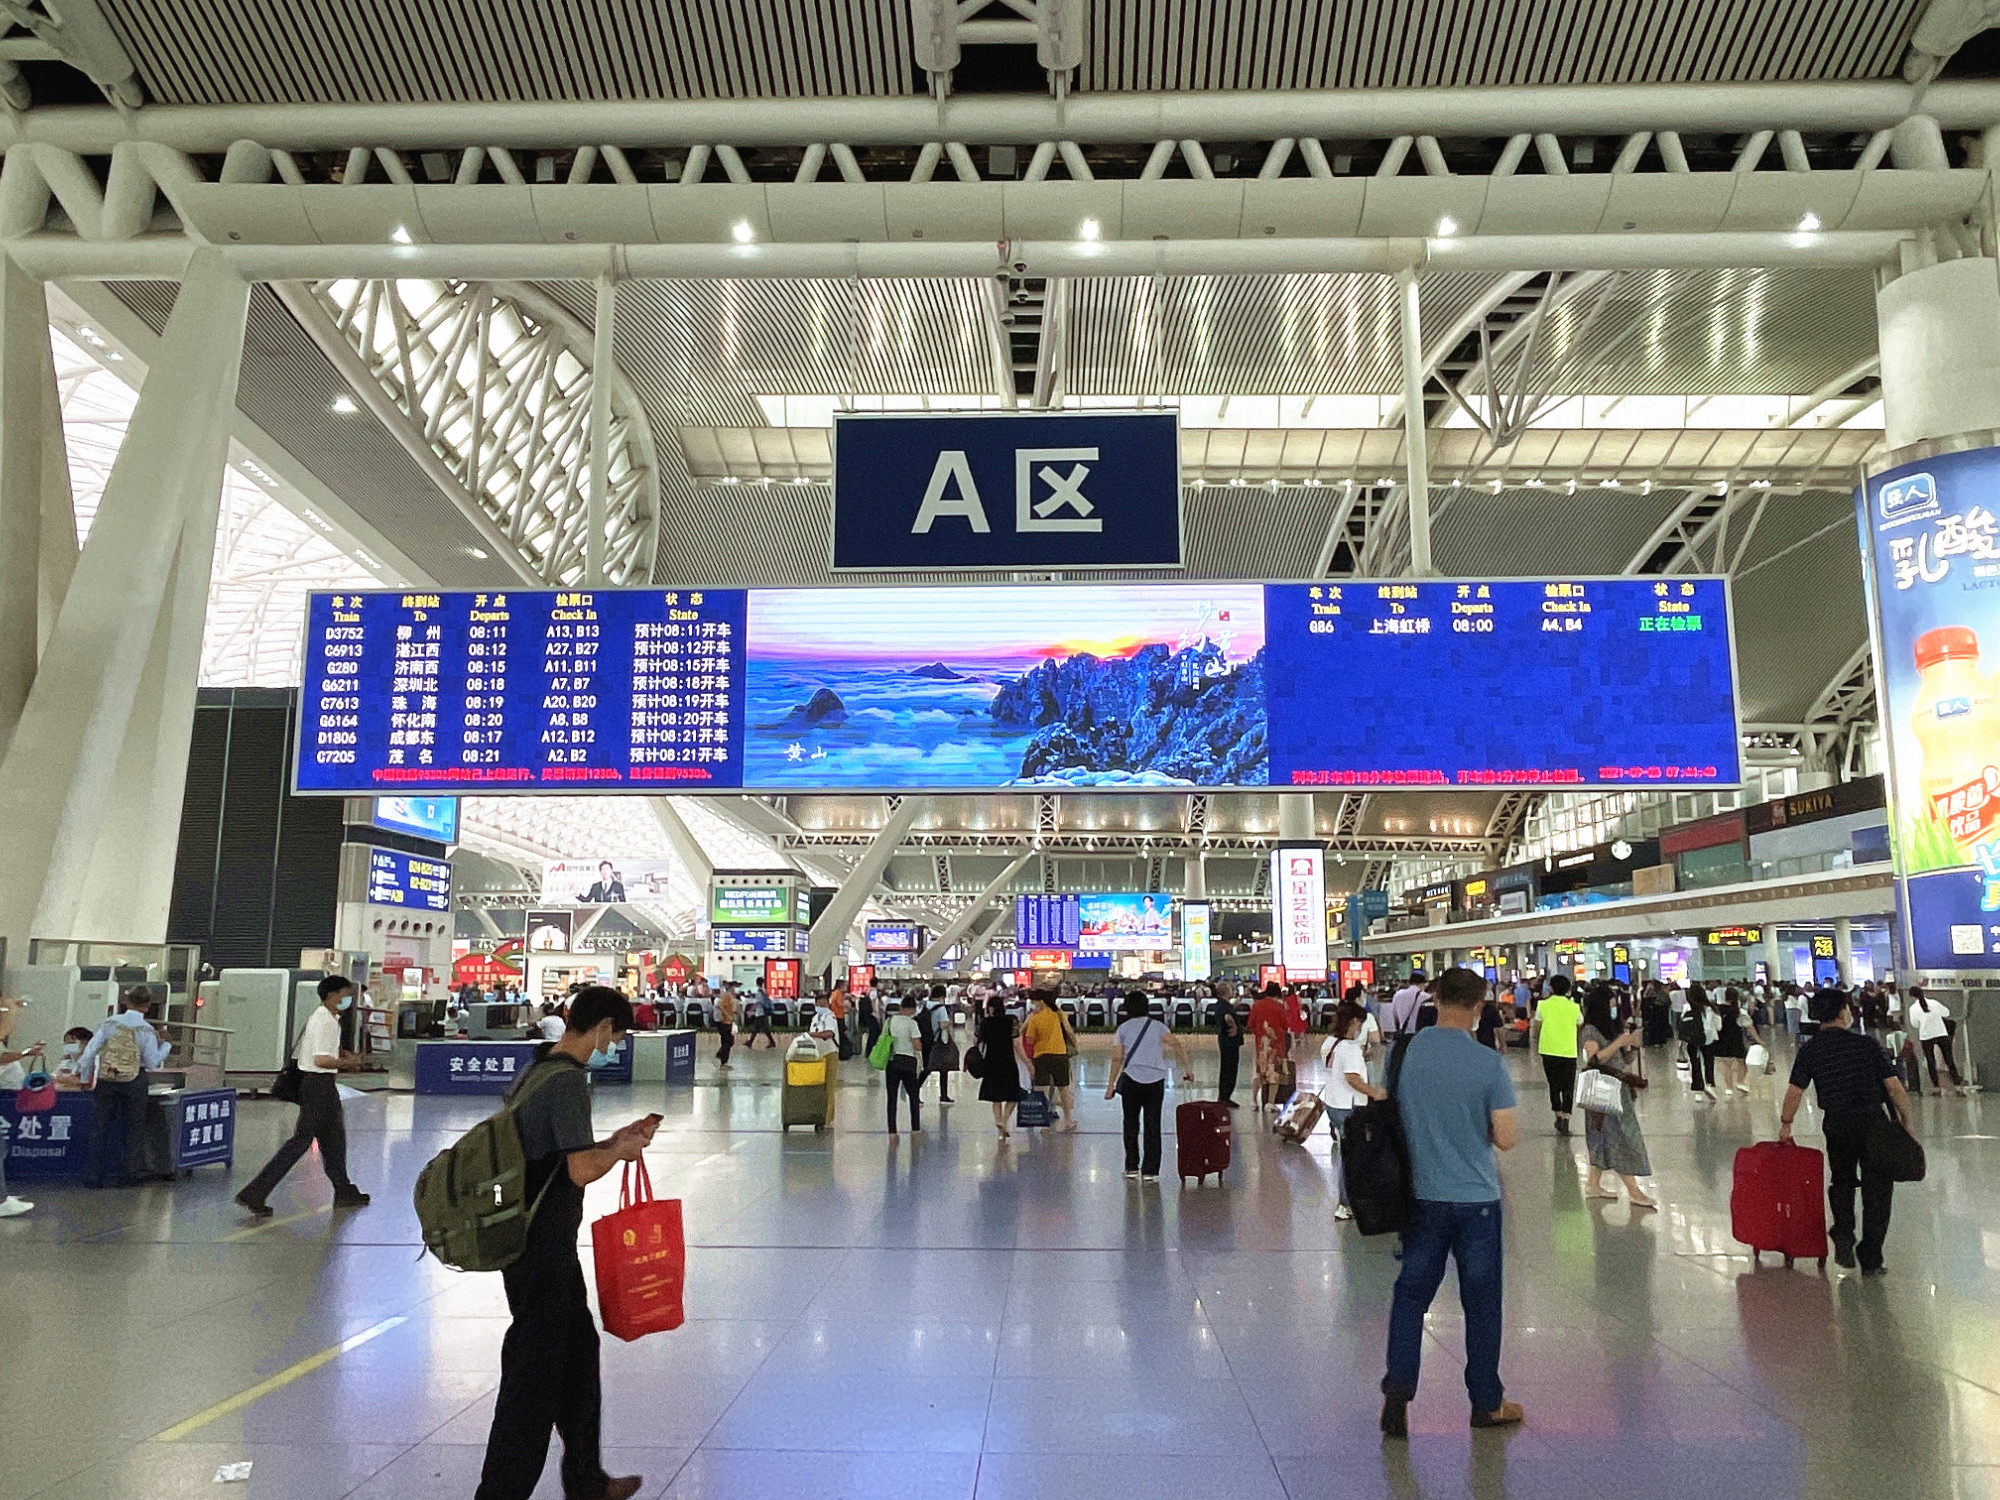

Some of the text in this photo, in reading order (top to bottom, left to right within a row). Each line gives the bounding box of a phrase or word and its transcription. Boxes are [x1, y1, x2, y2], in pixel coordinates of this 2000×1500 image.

[1311, 603, 1340, 614] Train
[1390, 603, 1405, 614] To
[1451, 602, 1493, 615] Departs
[1542, 601, 1591, 612] Check In
[1659, 601, 1690, 612] State
[333, 611, 359, 622] Train
[414, 611, 427, 621] To
[470, 611, 509, 623] Departs
[551, 609, 597, 620] Check In
[669, 609, 698, 620] State
[1369, 618, 1430, 634] 上海虹桥
[1453, 619, 1493, 632] 08:00
[1640, 616, 1702, 631] 正在检票
[326, 627, 363, 640] D3752
[470, 626, 505, 638] 08:11
[396, 642, 440, 657] 湛江西
[469, 643, 506, 656] 08:12
[327, 662, 357, 674] G280
[394, 660, 439, 675] 济南西
[468, 661, 505, 673] 08:15
[322, 679, 358, 691] G6211
[393, 677, 438, 692] 深圳北
[467, 678, 504, 690] 08:18
[466, 696, 503, 709] 08:19
[320, 715, 357, 727] G6164
[391, 713, 436, 728] 怀化南
[465, 714, 502, 726] 08:20
[318, 732, 355, 744] D1806
[390, 730, 434, 745] 成都东
[464, 731, 500, 743] 08:17
[463, 750, 499, 762] 08:21
[783, 741, 828, 762] 黄山
[1788, 794, 1834, 817] SUKIYA
[449, 1056, 516, 1073] 安全处置
[0, 1115, 72, 1141] 全处置
[11, 1145, 66, 1158] Disposal
